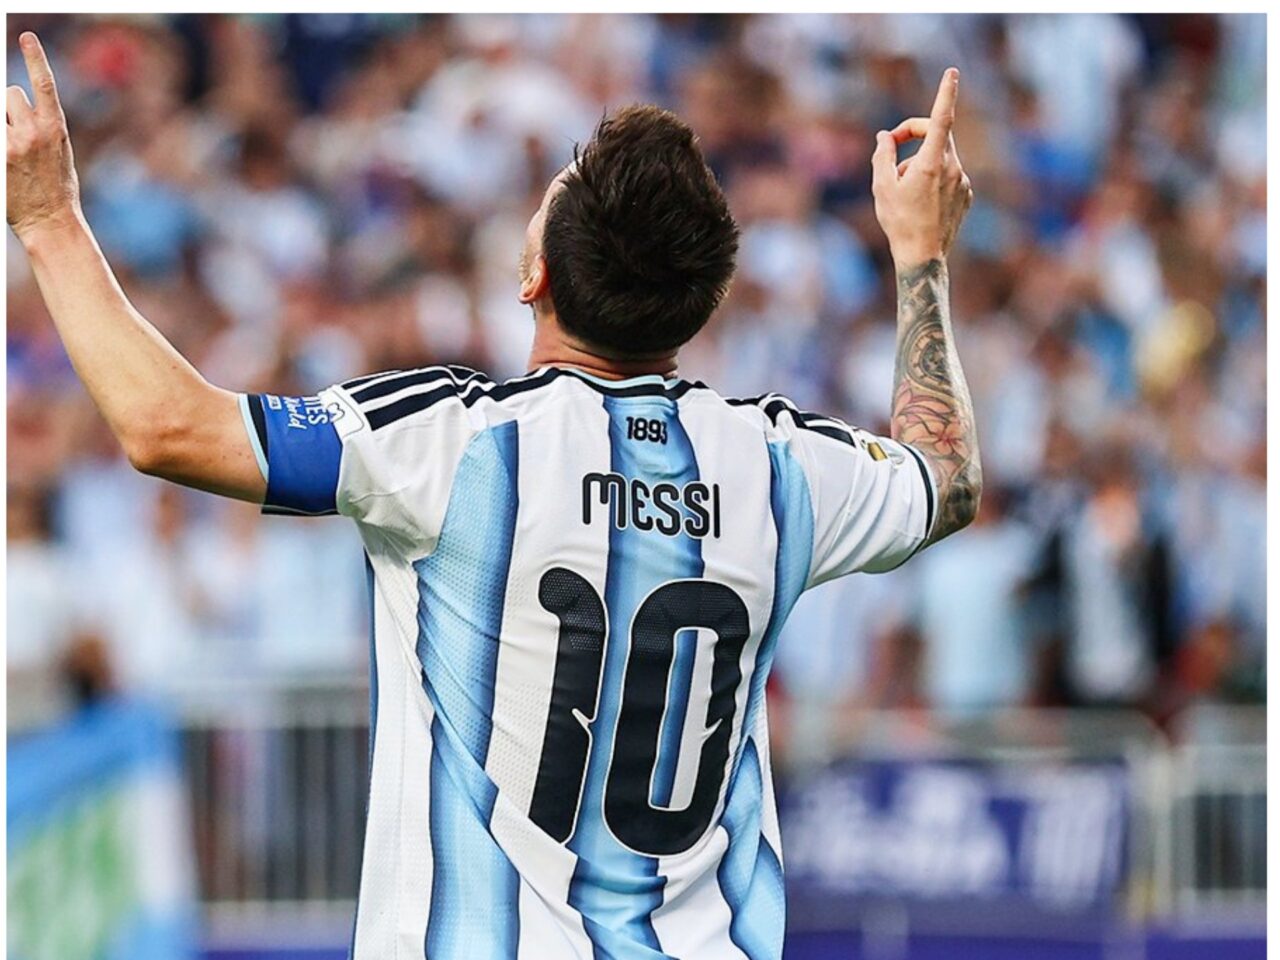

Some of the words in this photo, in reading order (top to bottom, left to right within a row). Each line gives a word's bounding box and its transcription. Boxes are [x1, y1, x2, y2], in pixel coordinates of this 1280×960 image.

[625, 416, 668, 445] 1893
[582, 472, 721, 539] MESSI
[528, 566, 751, 856] 10
